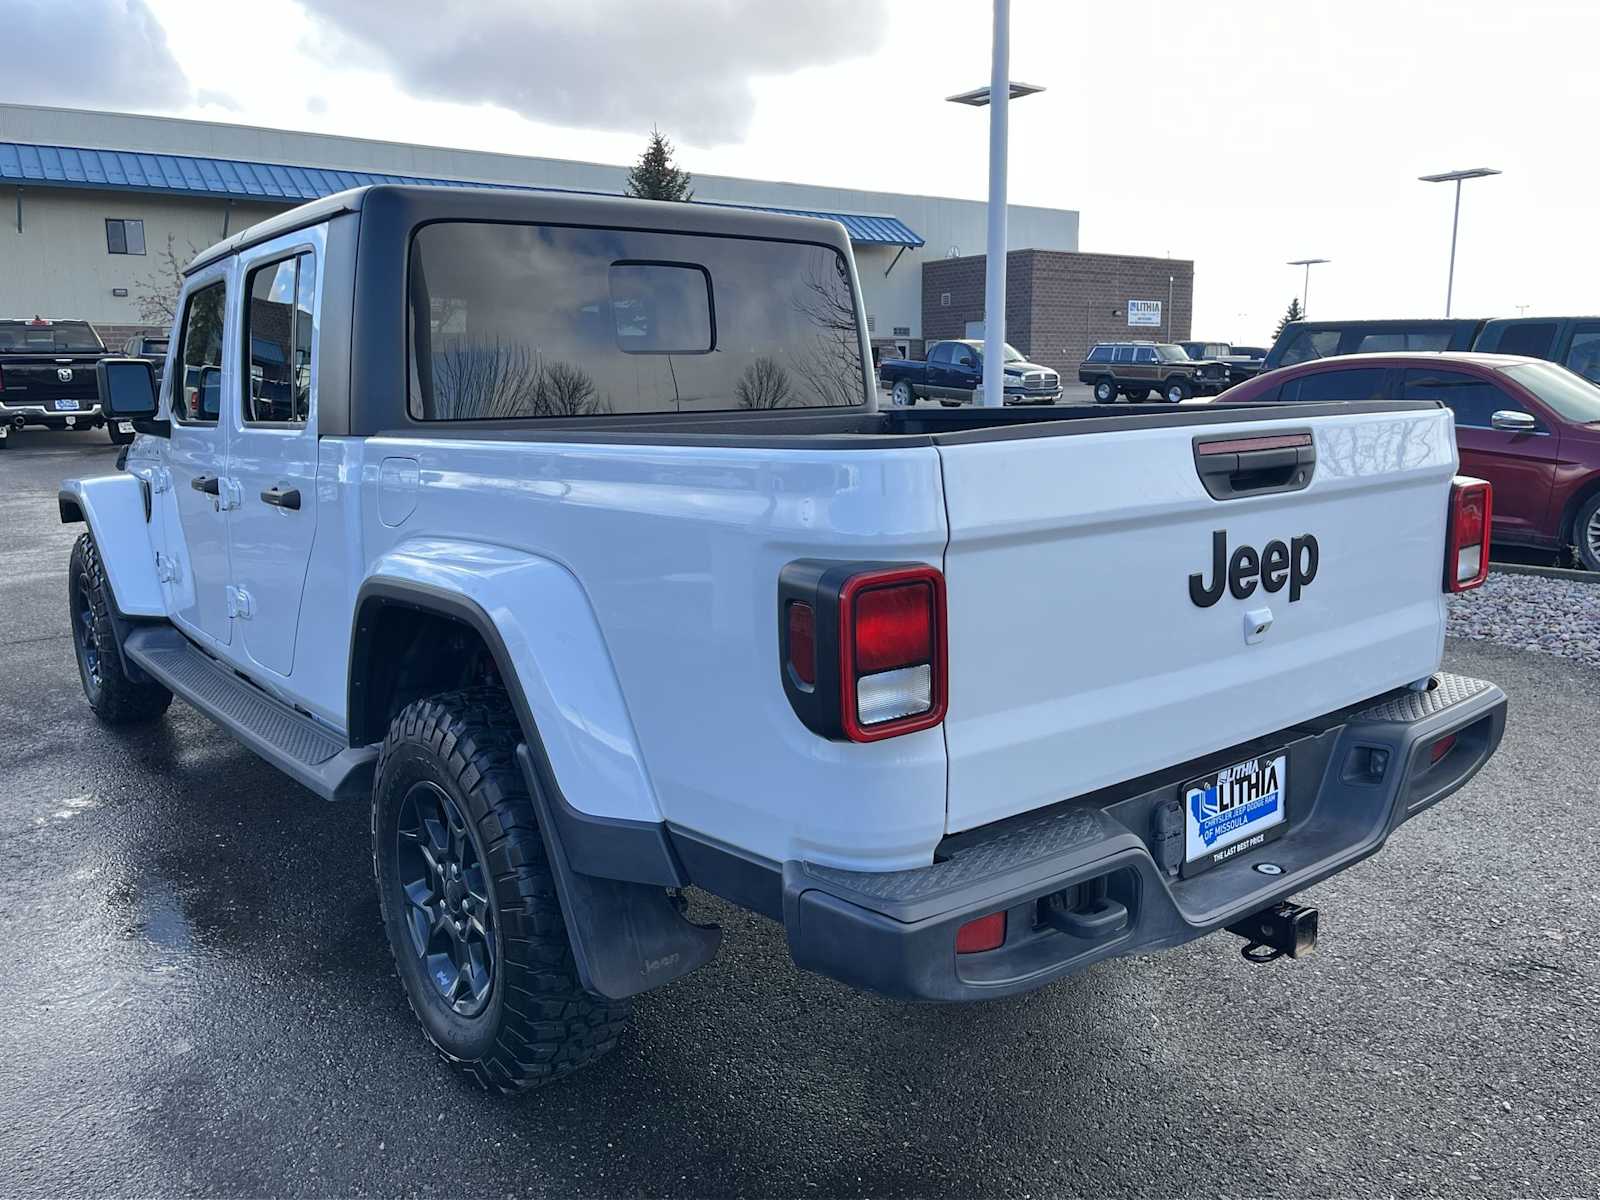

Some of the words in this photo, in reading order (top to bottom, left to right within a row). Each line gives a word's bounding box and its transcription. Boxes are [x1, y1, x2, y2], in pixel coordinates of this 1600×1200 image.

[1189, 529, 1319, 608] Jeep
[1219, 766, 1279, 811] LITHIA
[1233, 806, 1247, 819] JEEP
[1204, 829, 1214, 841] OF
[1214, 815, 1248, 836] MISSOULA
[1213, 851, 1224, 862] THE
[1224, 845, 1237, 858] LAST
[1237, 840, 1250, 852] BEST
[1250, 834, 1265, 846] PRICE
